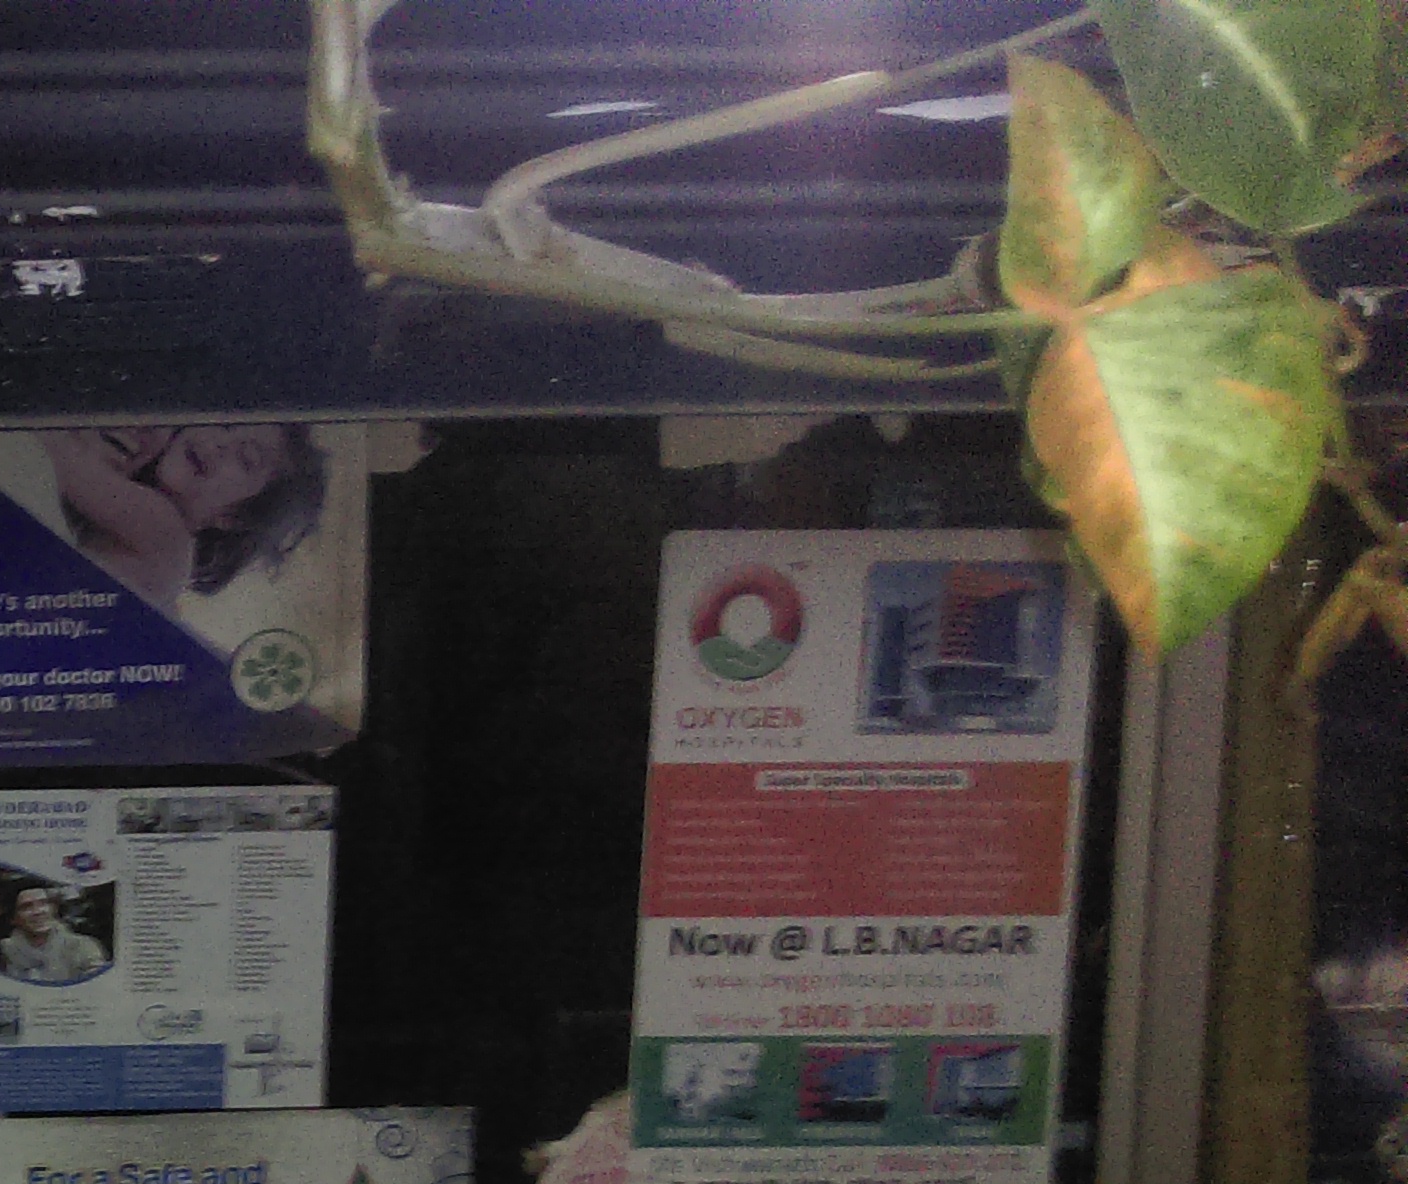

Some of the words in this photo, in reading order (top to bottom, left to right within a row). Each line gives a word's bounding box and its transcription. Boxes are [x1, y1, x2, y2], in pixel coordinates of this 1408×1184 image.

[24, 590, 119, 609] another
[43, 667, 116, 686] doctor
[119, 663, 183, 684] NOW!
[21, 694, 58, 713] 102
[675, 706, 806, 730] OXYGEN
[668, 926, 757, 957] Now
[821, 924, 1036, 956] L.B.NAGAR
